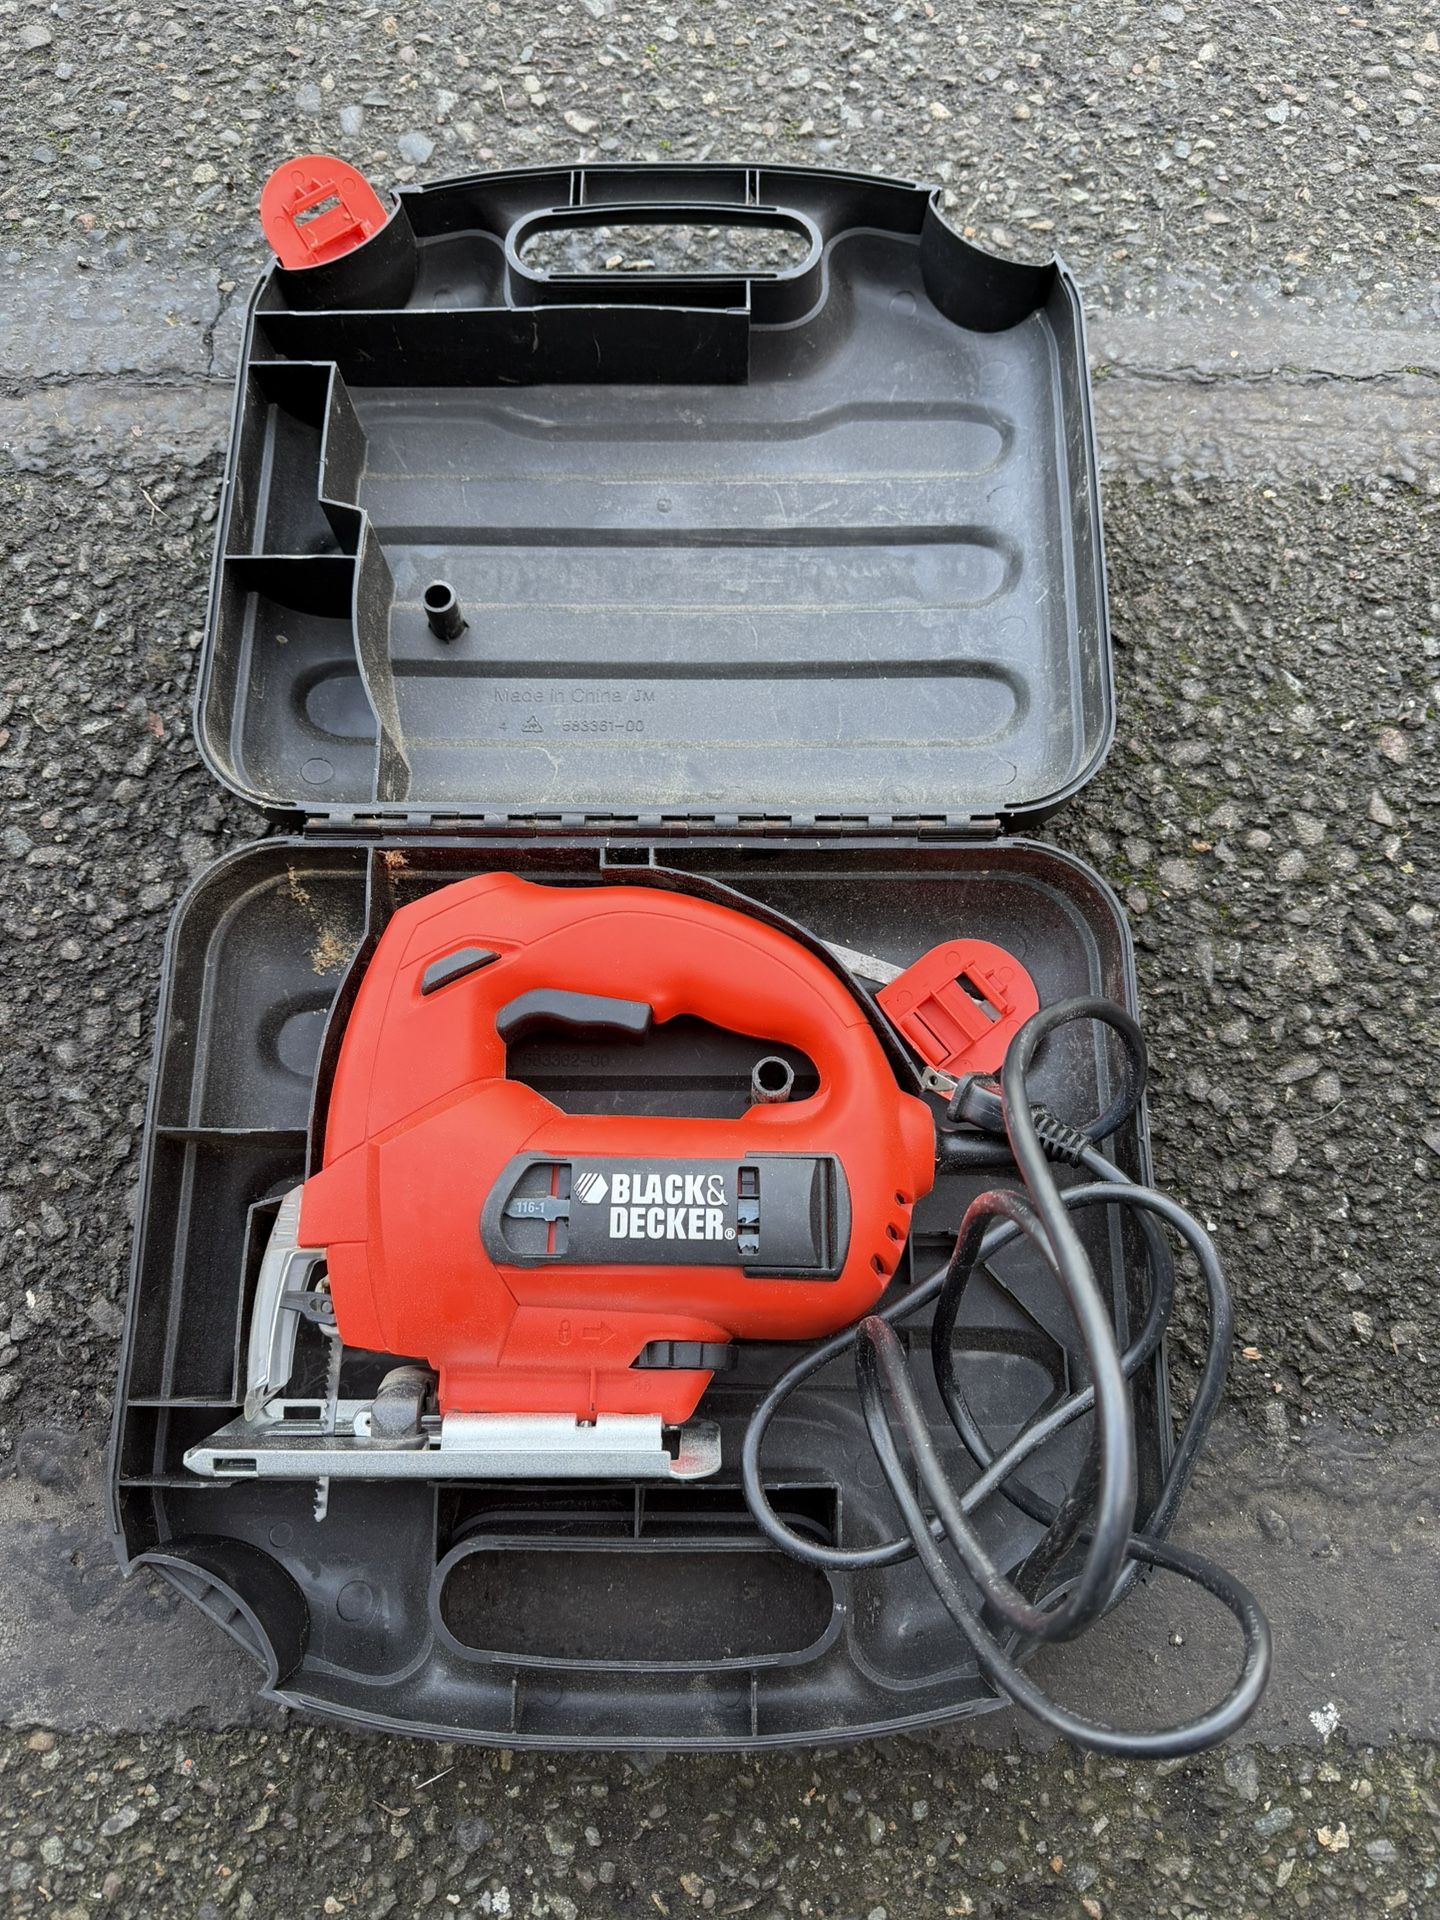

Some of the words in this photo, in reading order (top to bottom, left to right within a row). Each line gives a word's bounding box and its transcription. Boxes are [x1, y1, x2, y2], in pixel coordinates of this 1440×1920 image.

[494, 687, 544, 703] Made
[550, 687, 565, 703] in
[571, 687, 623, 703] China
[610, 1173, 729, 1206] BLACK&
[516, 1201, 545, 1214] 116-1
